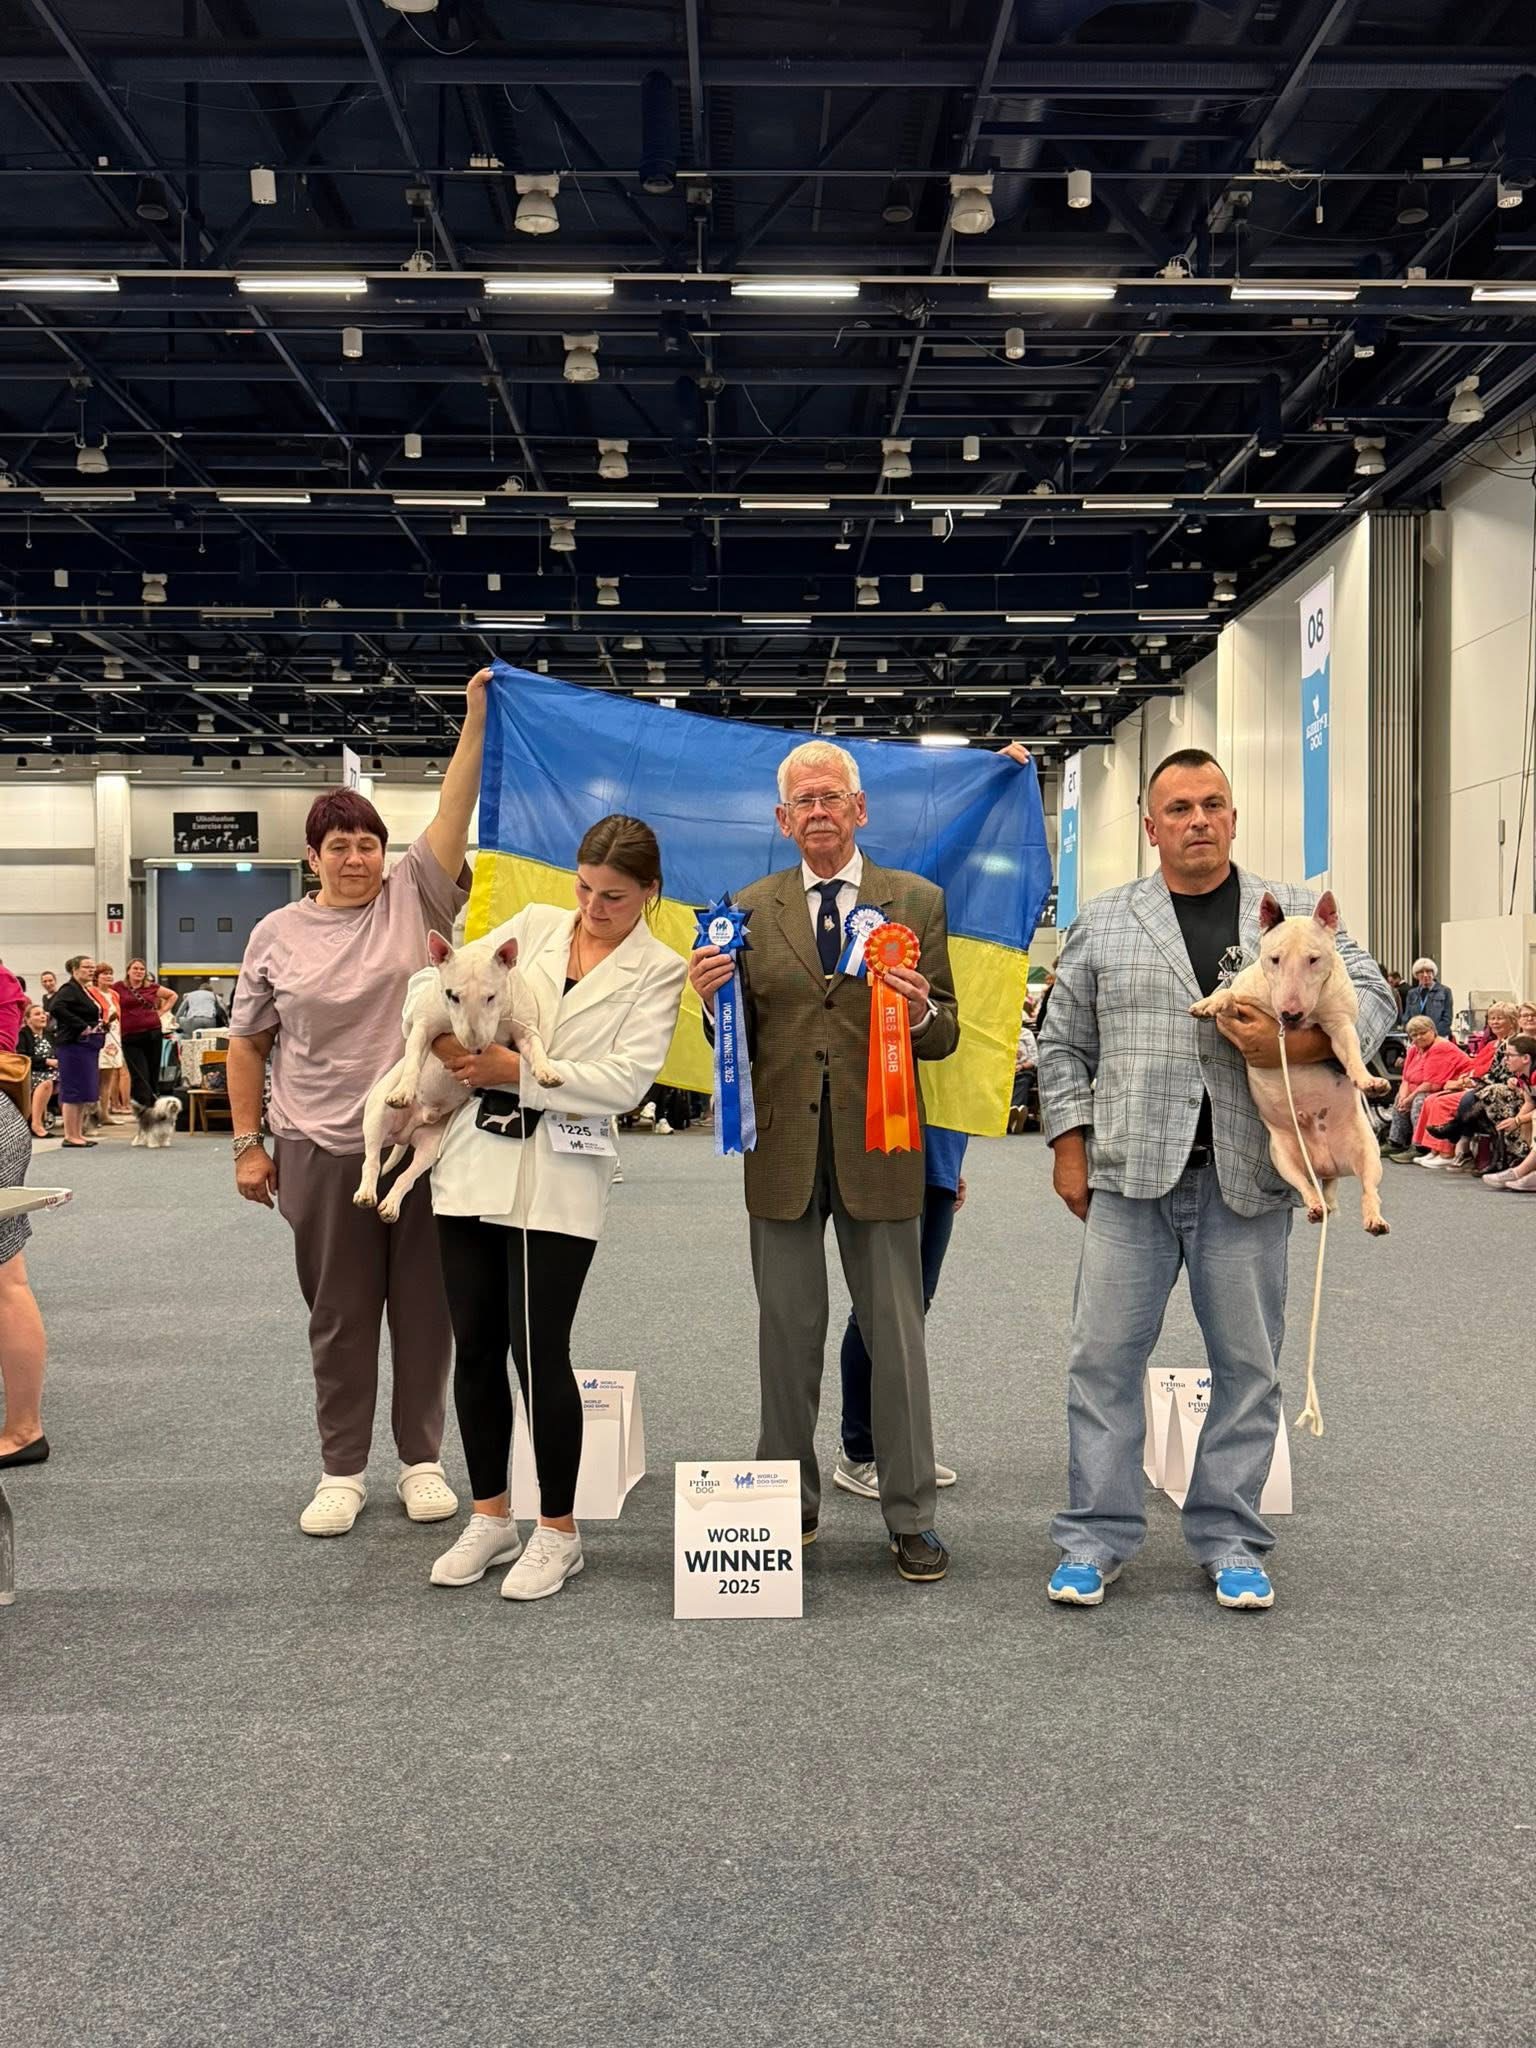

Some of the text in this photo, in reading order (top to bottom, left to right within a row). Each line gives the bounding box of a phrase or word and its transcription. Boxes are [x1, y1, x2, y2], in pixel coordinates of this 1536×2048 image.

[191, 822, 222, 830] Exercise
[885, 1006, 897, 1032] RES
[723, 1002, 735, 1084] WORLD WINNER 2025
[558, 1123, 592, 1137] 1225
[689, 1478, 721, 1488] Prima
[695, 1486, 715, 1494] DOG
[707, 1528, 771, 1543] WORLD
[684, 1549, 794, 1573] WINNER
[718, 1579, 761, 1594] 2025
